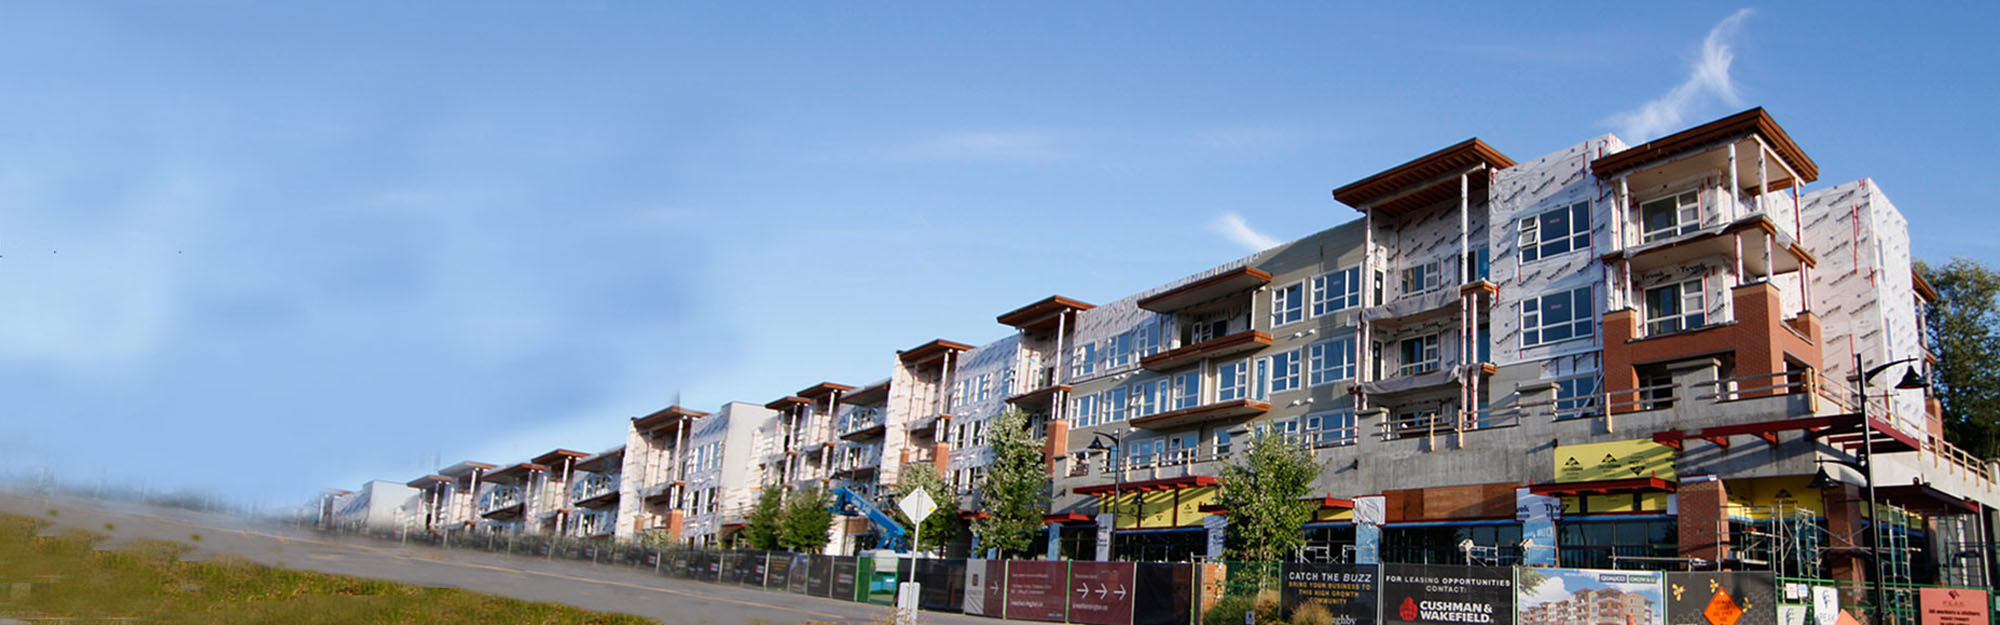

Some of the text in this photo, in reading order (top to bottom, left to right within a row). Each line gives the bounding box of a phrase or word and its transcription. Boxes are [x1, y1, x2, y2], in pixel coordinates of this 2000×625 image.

[1289, 572, 1372, 583] CATCH THE BUZZ
[1404, 576, 1440, 584] LEASING
[1442, 577, 1511, 587] OPPORTUNITIES
[1425, 585, 1467, 593] CONTACT:
[1419, 600, 1493, 613] CUSHMAN &
[1420, 610, 1490, 623] WAKEFIELD
